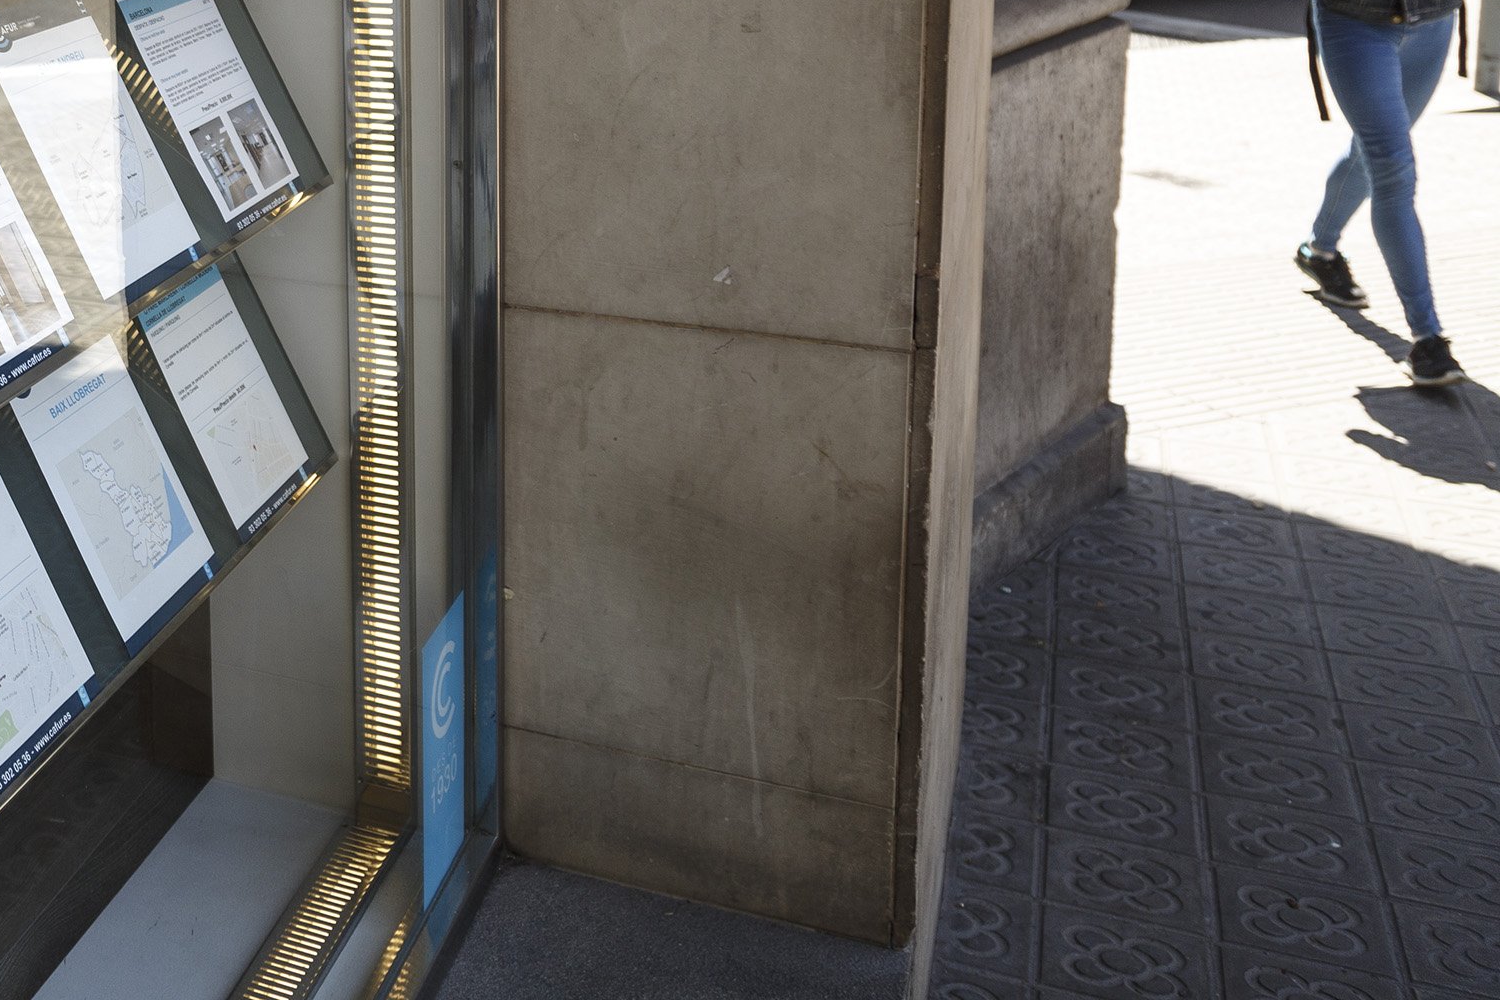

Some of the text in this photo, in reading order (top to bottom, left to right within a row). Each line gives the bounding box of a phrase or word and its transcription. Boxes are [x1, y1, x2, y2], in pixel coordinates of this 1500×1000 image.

[128, 6, 153, 20] BARCELONA
[57, 51, 84, 67] ANDREU
[9, 344, 51, 378] www.cafur.es
[49, 373, 106, 419] BAIX LLOBREGAT
[0, 766, 15, 786] 302
[12, 758, 23, 774] 05
[20, 749, 31, 766] 36
[32, 708, 72, 753] www.cafur.es
